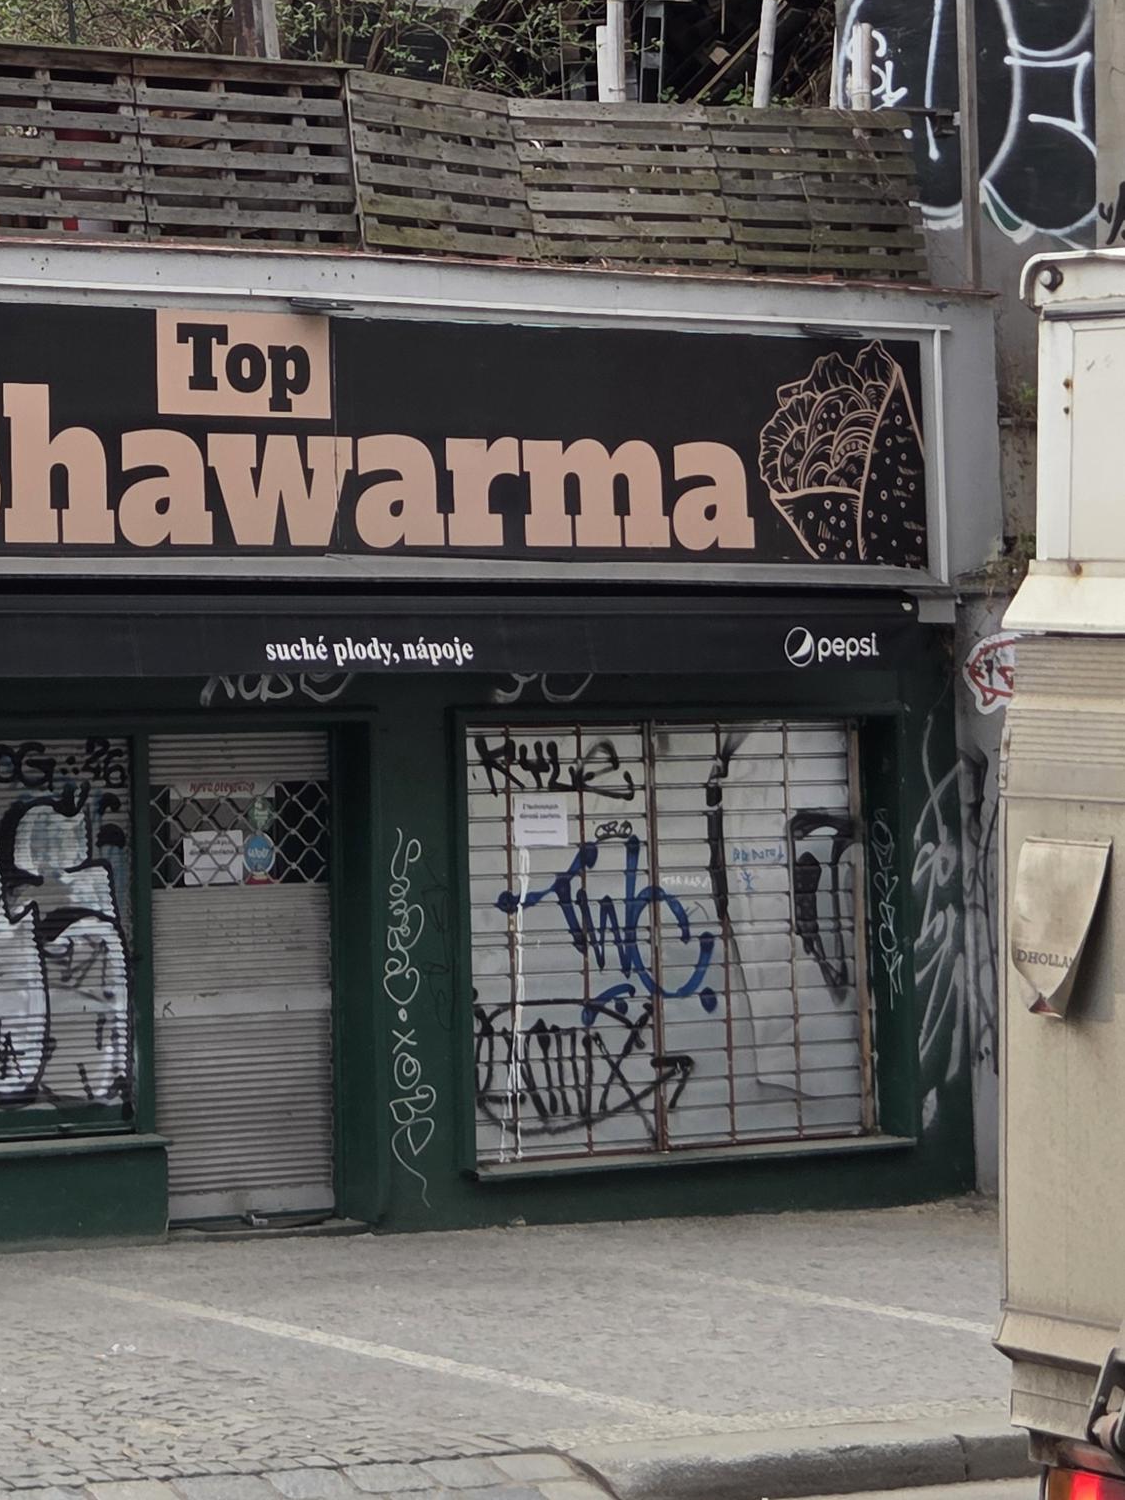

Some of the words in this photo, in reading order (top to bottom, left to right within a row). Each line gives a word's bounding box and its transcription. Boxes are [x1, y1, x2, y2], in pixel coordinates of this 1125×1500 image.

[177, 322, 311, 412] Top
[265, 635, 328, 661] suché
[332, 637, 400, 666] plody,
[402, 636, 474, 665] nápoje
[817, 632, 879, 662] pepsi
